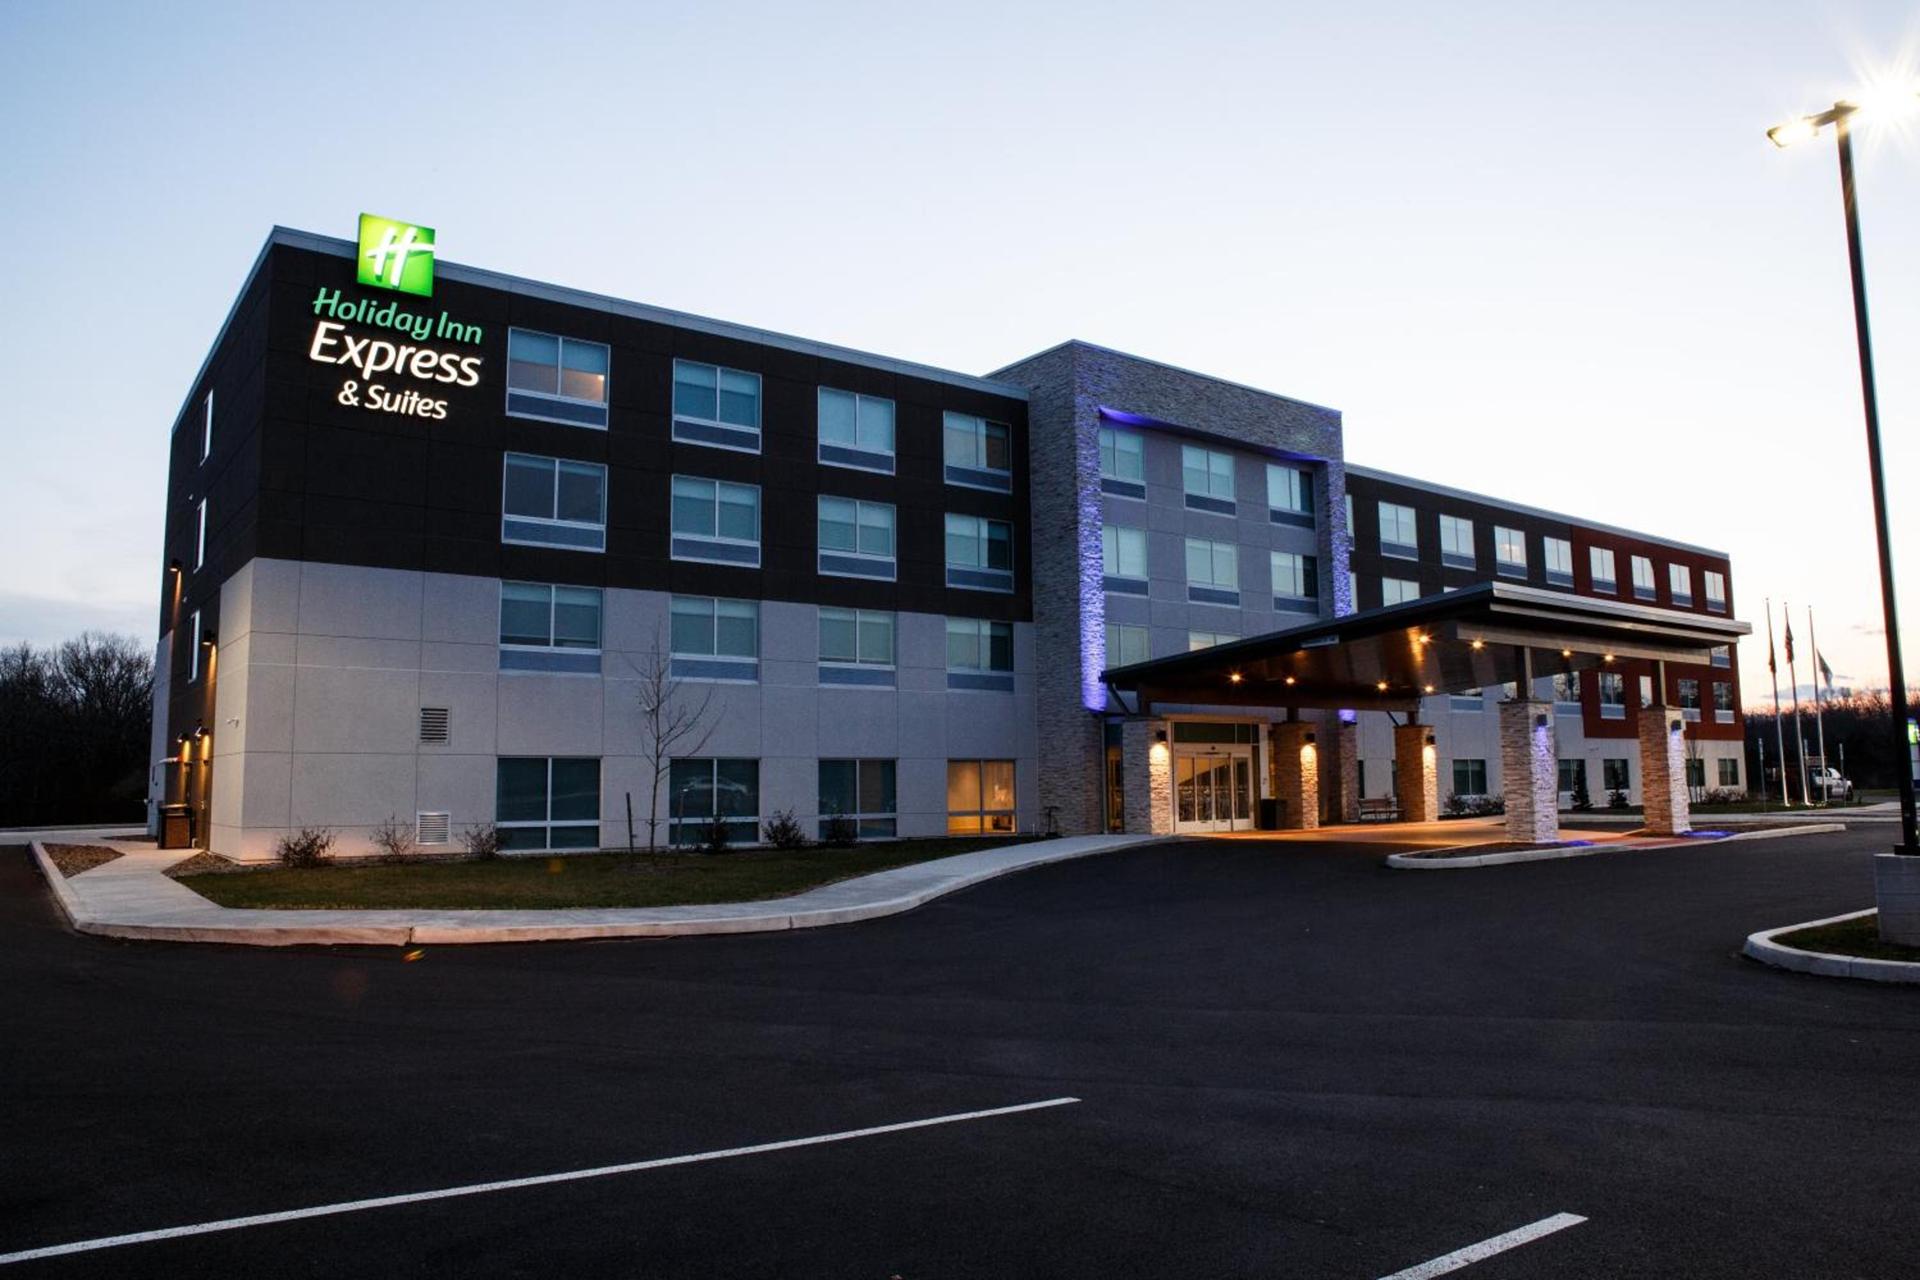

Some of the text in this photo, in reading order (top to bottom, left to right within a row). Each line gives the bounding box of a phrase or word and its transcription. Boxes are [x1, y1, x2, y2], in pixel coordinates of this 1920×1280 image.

[313, 287, 482, 344] Holiday Inn
[309, 321, 482, 387] Express
[338, 380, 448, 419] & Suites
